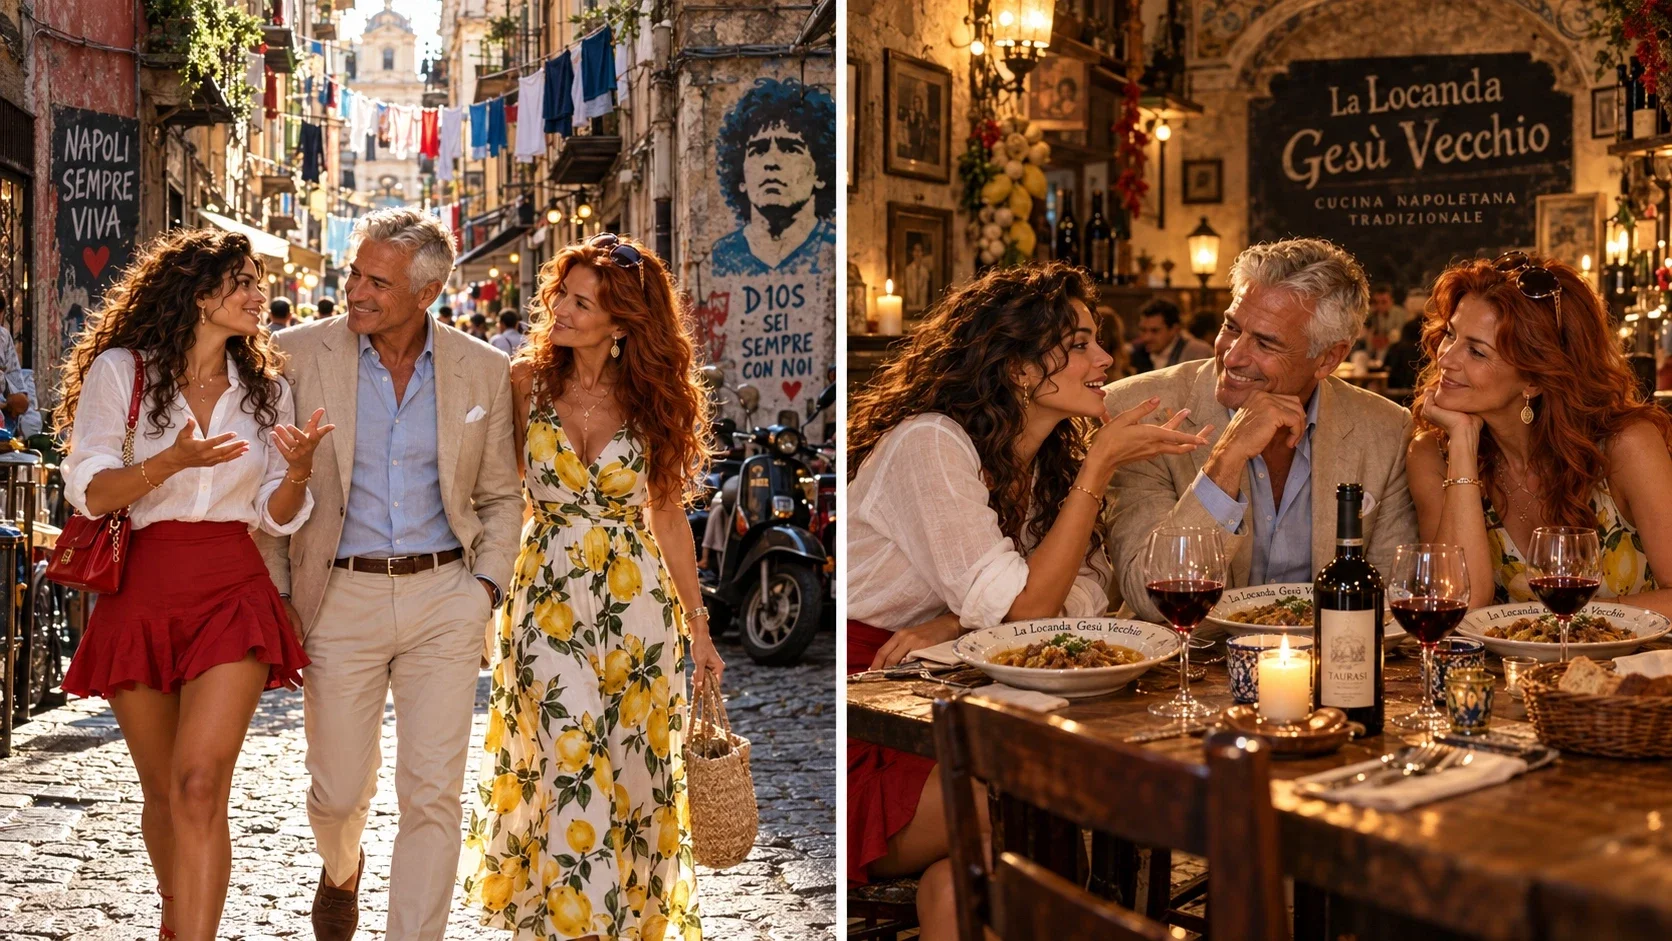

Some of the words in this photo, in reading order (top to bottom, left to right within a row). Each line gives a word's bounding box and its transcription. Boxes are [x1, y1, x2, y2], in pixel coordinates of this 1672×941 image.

[1328, 86, 1361, 117] La
[1365, 67, 1503, 114] Locanda
[64, 124, 130, 163] NAPOLI
[1281, 124, 1391, 190] Gesù
[1399, 112, 1551, 170] Vecchio
[62, 167, 135, 202] SEMPRE
[1314, 196, 1384, 209] CUCINA
[1396, 191, 1517, 207] NAPOLETANA
[71, 204, 121, 241] VIVA
[1348, 211, 1484, 226] TRADIZIONALE
[763, 313, 788, 333] SEI
[742, 332, 813, 358] SEMPRE
[742, 359, 774, 379] CON
[781, 357, 812, 377] NOI
[1487, 611, 1500, 621] La
[1501, 605, 1539, 618] Locanda
[1014, 626, 1027, 637] La
[1030, 621, 1072, 634] Locanda
[1107, 622, 1142, 637] Vecchio
[1328, 671, 1368, 681] TAURASI
